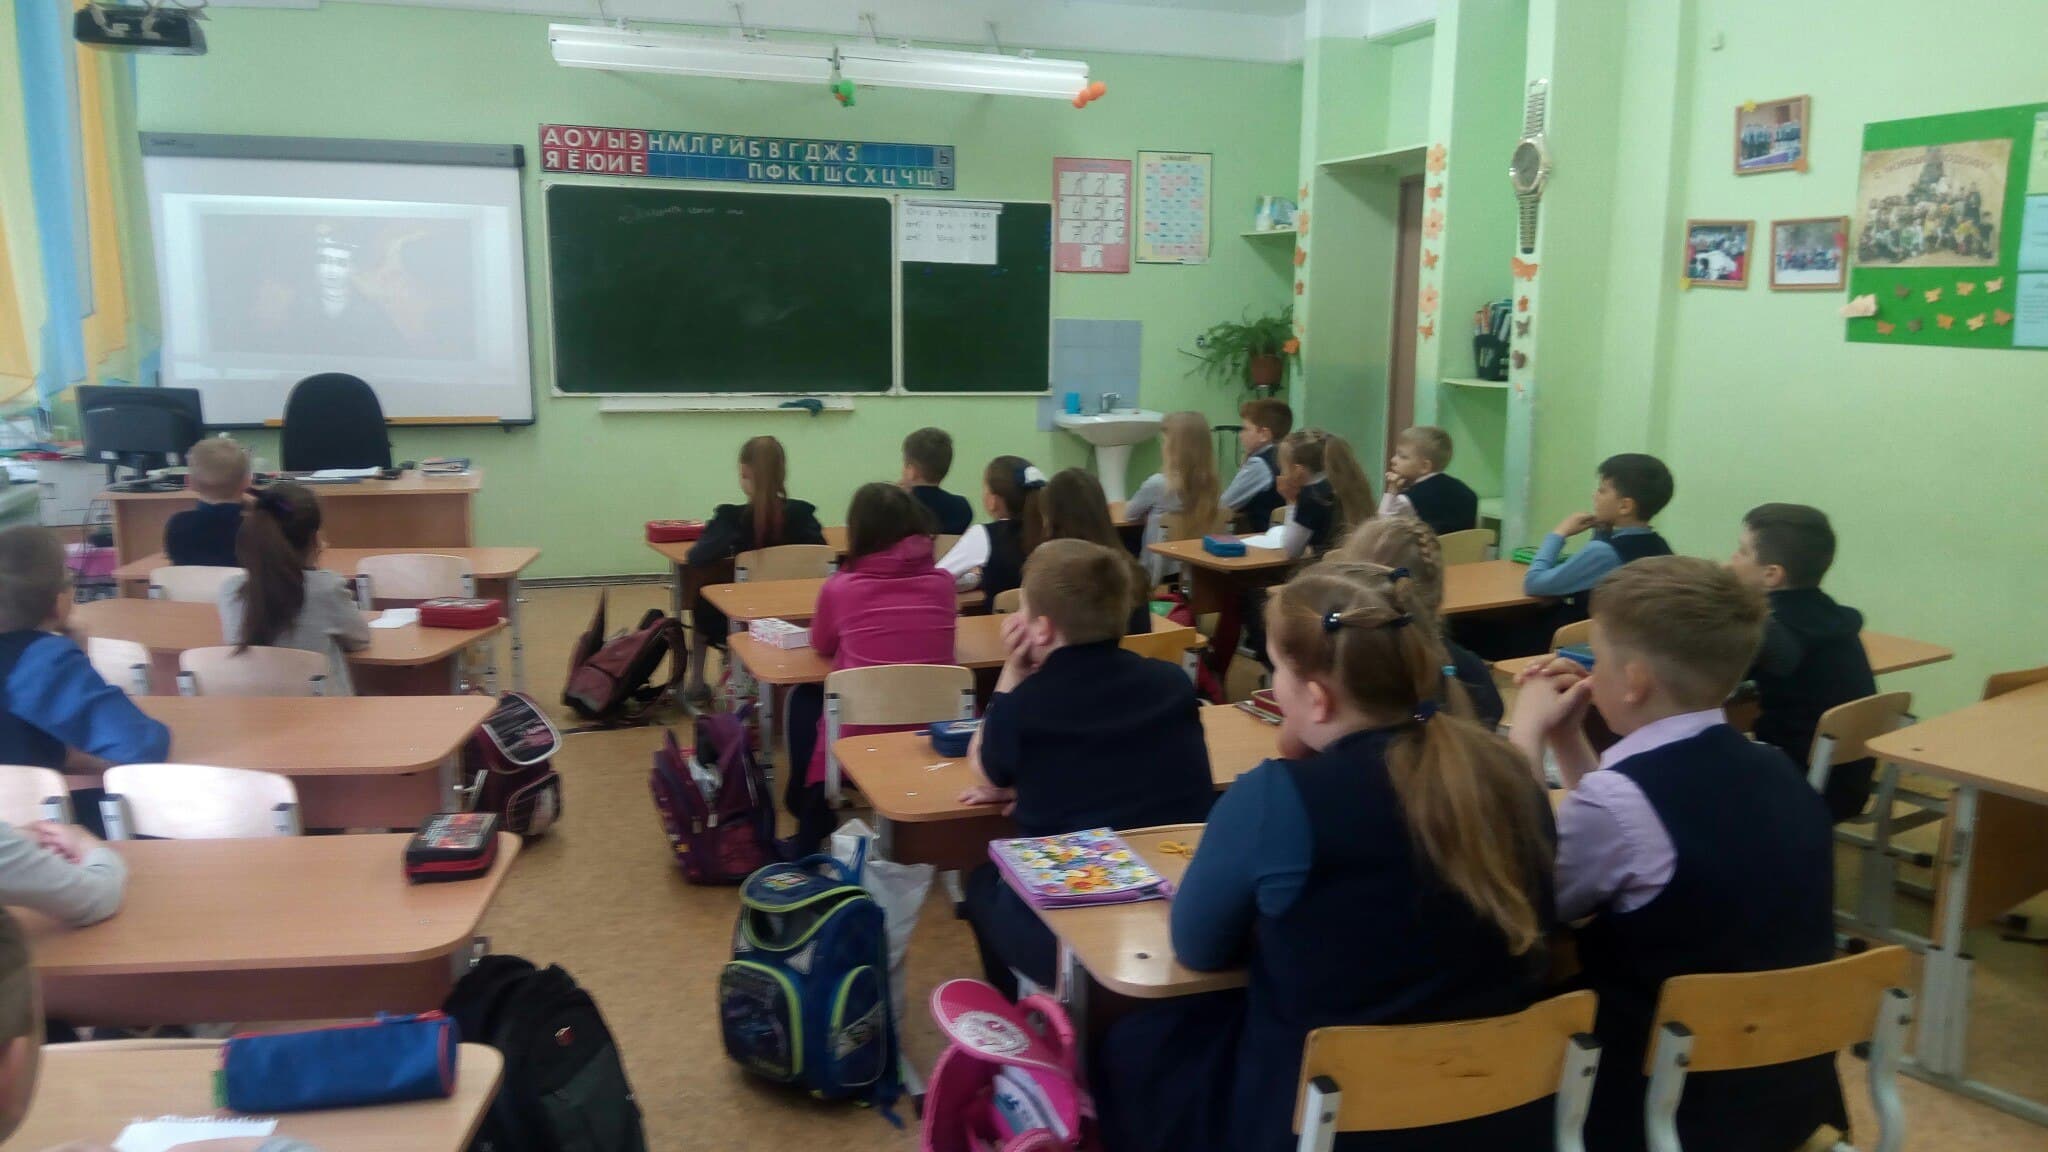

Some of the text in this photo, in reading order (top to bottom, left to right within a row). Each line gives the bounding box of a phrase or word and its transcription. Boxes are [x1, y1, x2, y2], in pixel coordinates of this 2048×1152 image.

[544, 129, 561, 145] А
[565, 129, 582, 146] О
[587, 131, 603, 147] У
[607, 132, 623, 148] Ы
[631, 133, 642, 150] Э
[649, 134, 662, 150] Н
[668, 135, 686, 152] М
[712, 138, 723, 153] Р
[731, 135, 744, 155] Й
[749, 141, 760, 157] Б
[769, 142, 779, 158] В
[789, 143, 800, 158] Г
[806, 144, 820, 161] Д
[824, 145, 840, 160] Ж
[846, 146, 857, 161] З
[546, 151, 559, 167] Я
[568, 150, 581, 169] Ё
[586, 153, 604, 170] Ю
[608, 155, 624, 171] И
[632, 156, 643, 173] Е
[749, 163, 761, 178] П
[767, 163, 783, 179] Ф
[789, 165, 801, 180] К
[808, 166, 819, 181] Т
[845, 167, 857, 183] С
[864, 169, 879, 183] Х
[882, 169, 896, 185] Ц
[901, 170, 913, 184] Ч
[918, 170, 934, 186] Щ
